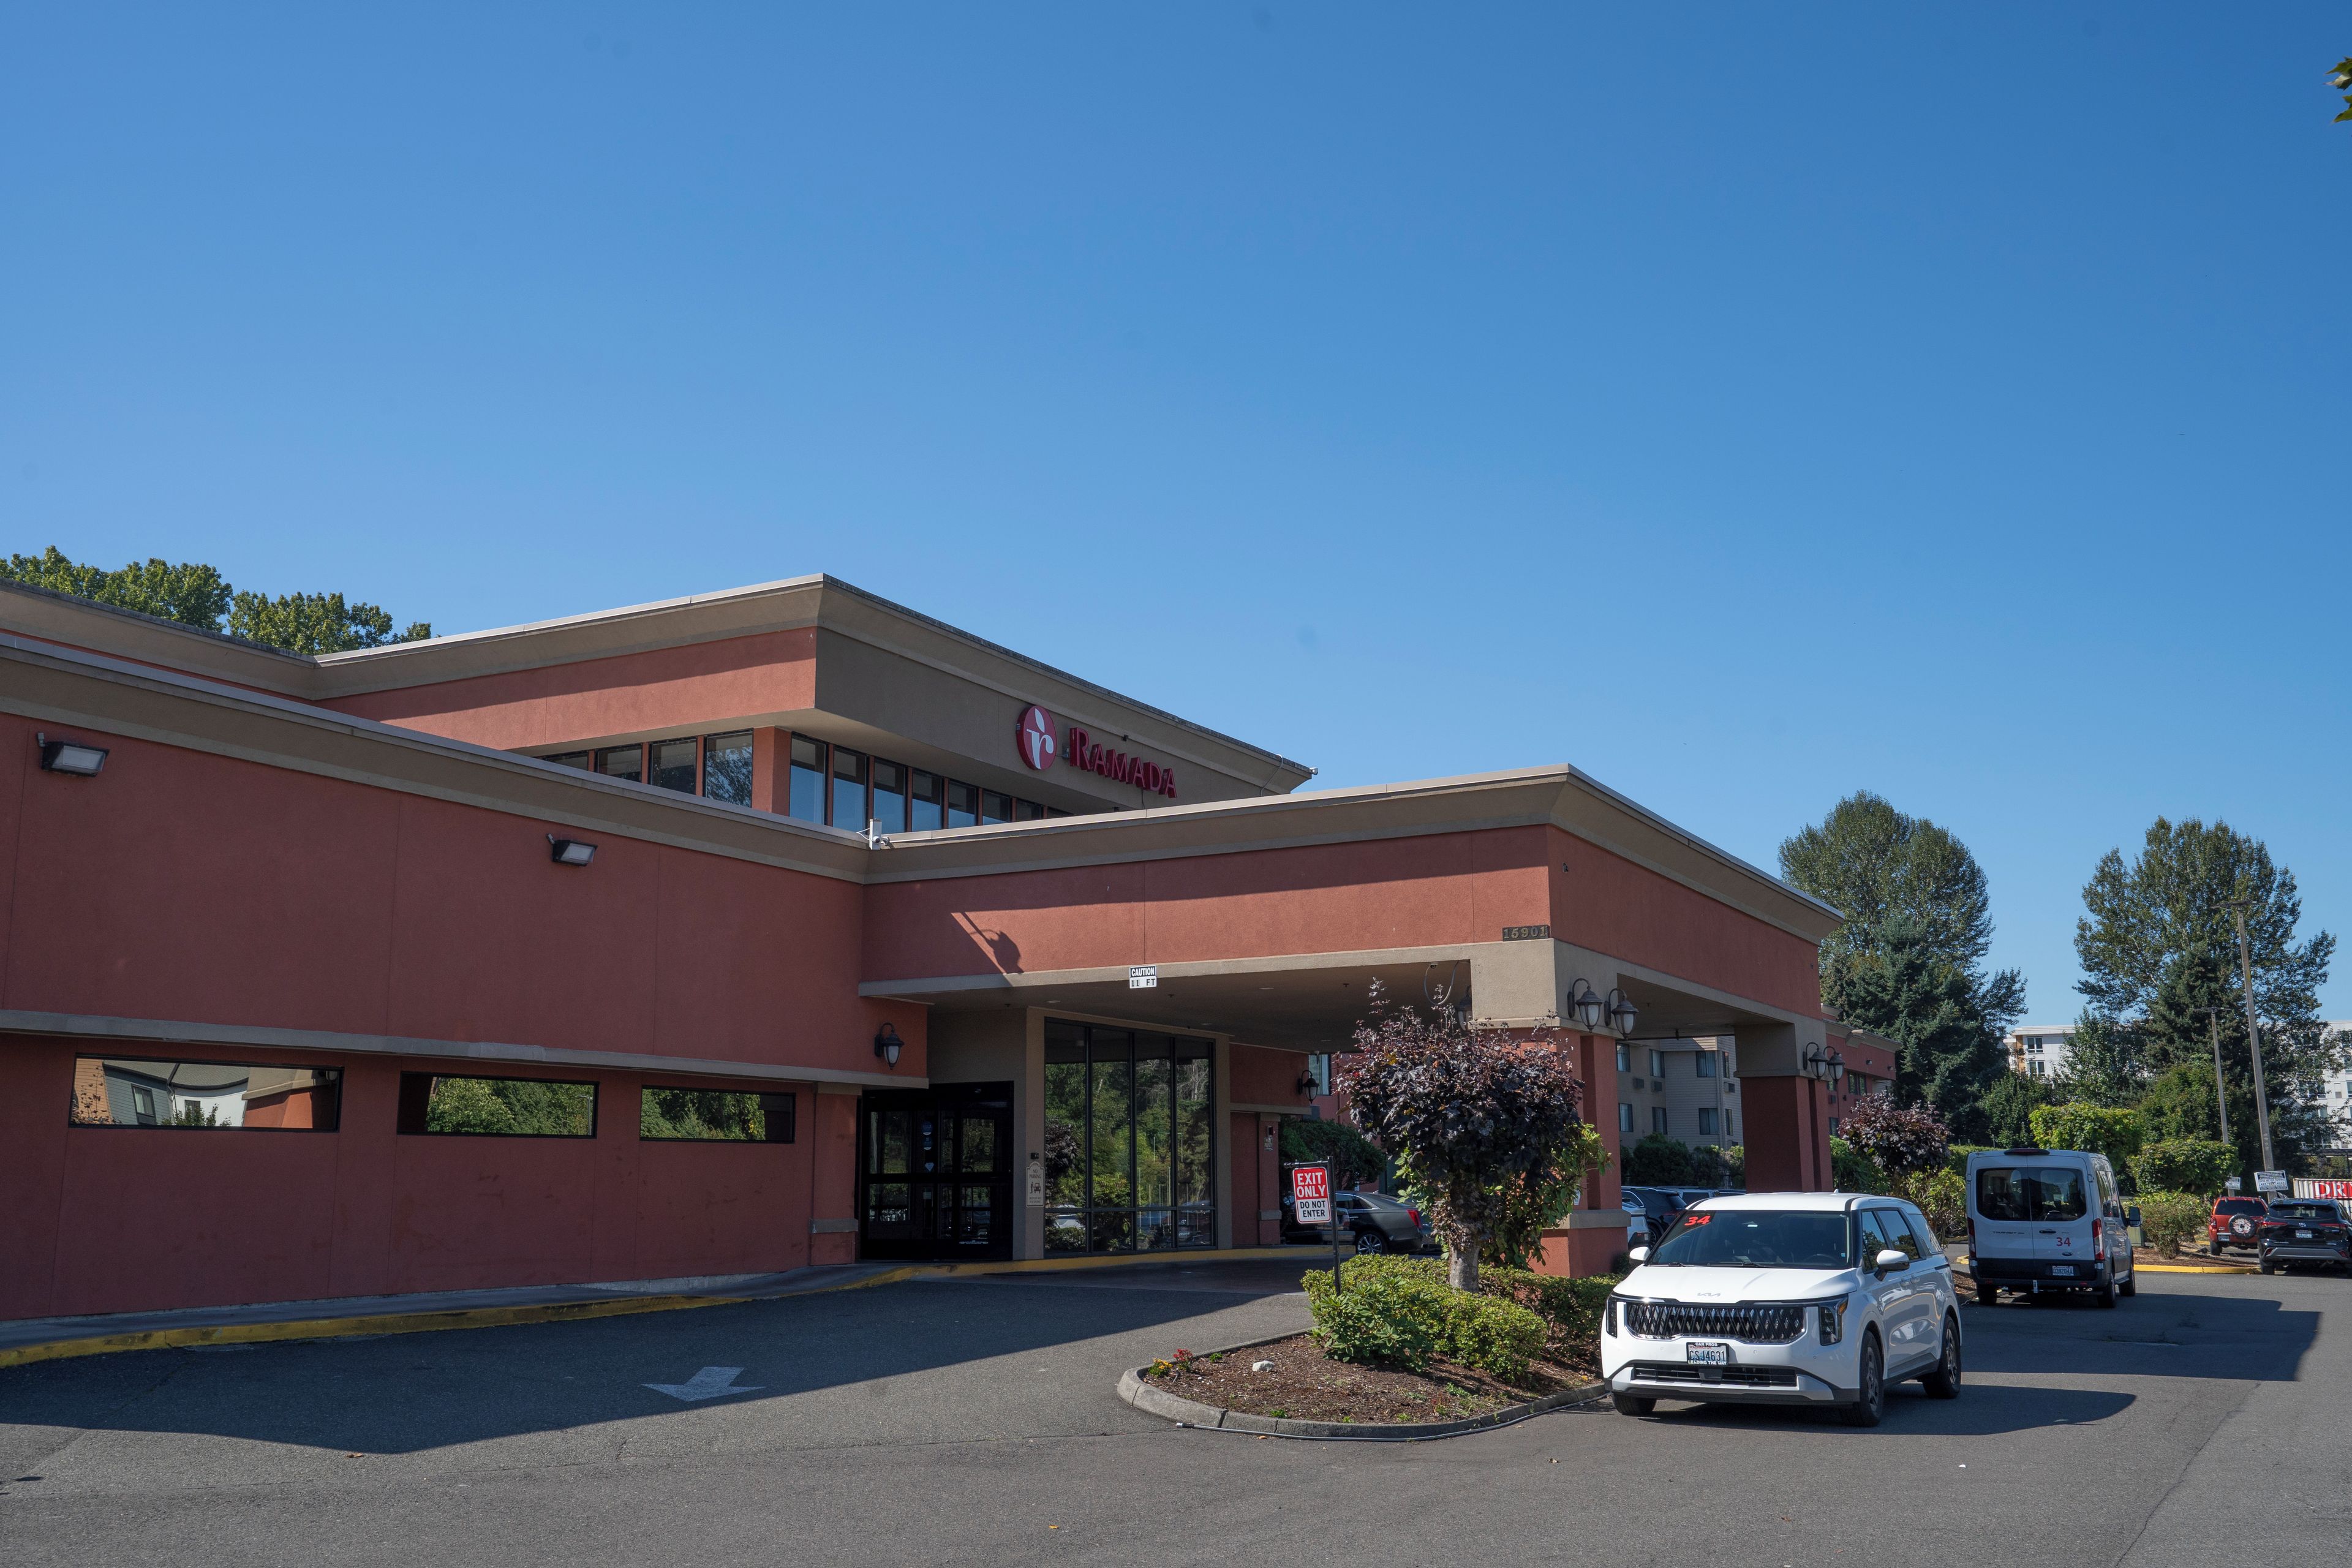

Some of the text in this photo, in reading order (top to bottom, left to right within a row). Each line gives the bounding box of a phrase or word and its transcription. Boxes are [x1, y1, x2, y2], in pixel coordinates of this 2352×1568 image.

[1069, 727, 1177, 798] RAMADA
[1504, 925, 1548, 939] 15901
[1131, 967, 1155, 977] CAUTION
[1297, 1172, 1322, 1185] EXIT
[1296, 1185, 1326, 1198] ONLY
[2315, 1183, 2352, 1197] DR
[1303, 1209, 1325, 1218] ENTER
[1684, 1215, 1711, 1226] 34
[2056, 1237, 2071, 1247] 34
[1689, 1350, 1725, 1362] CSJ4631
